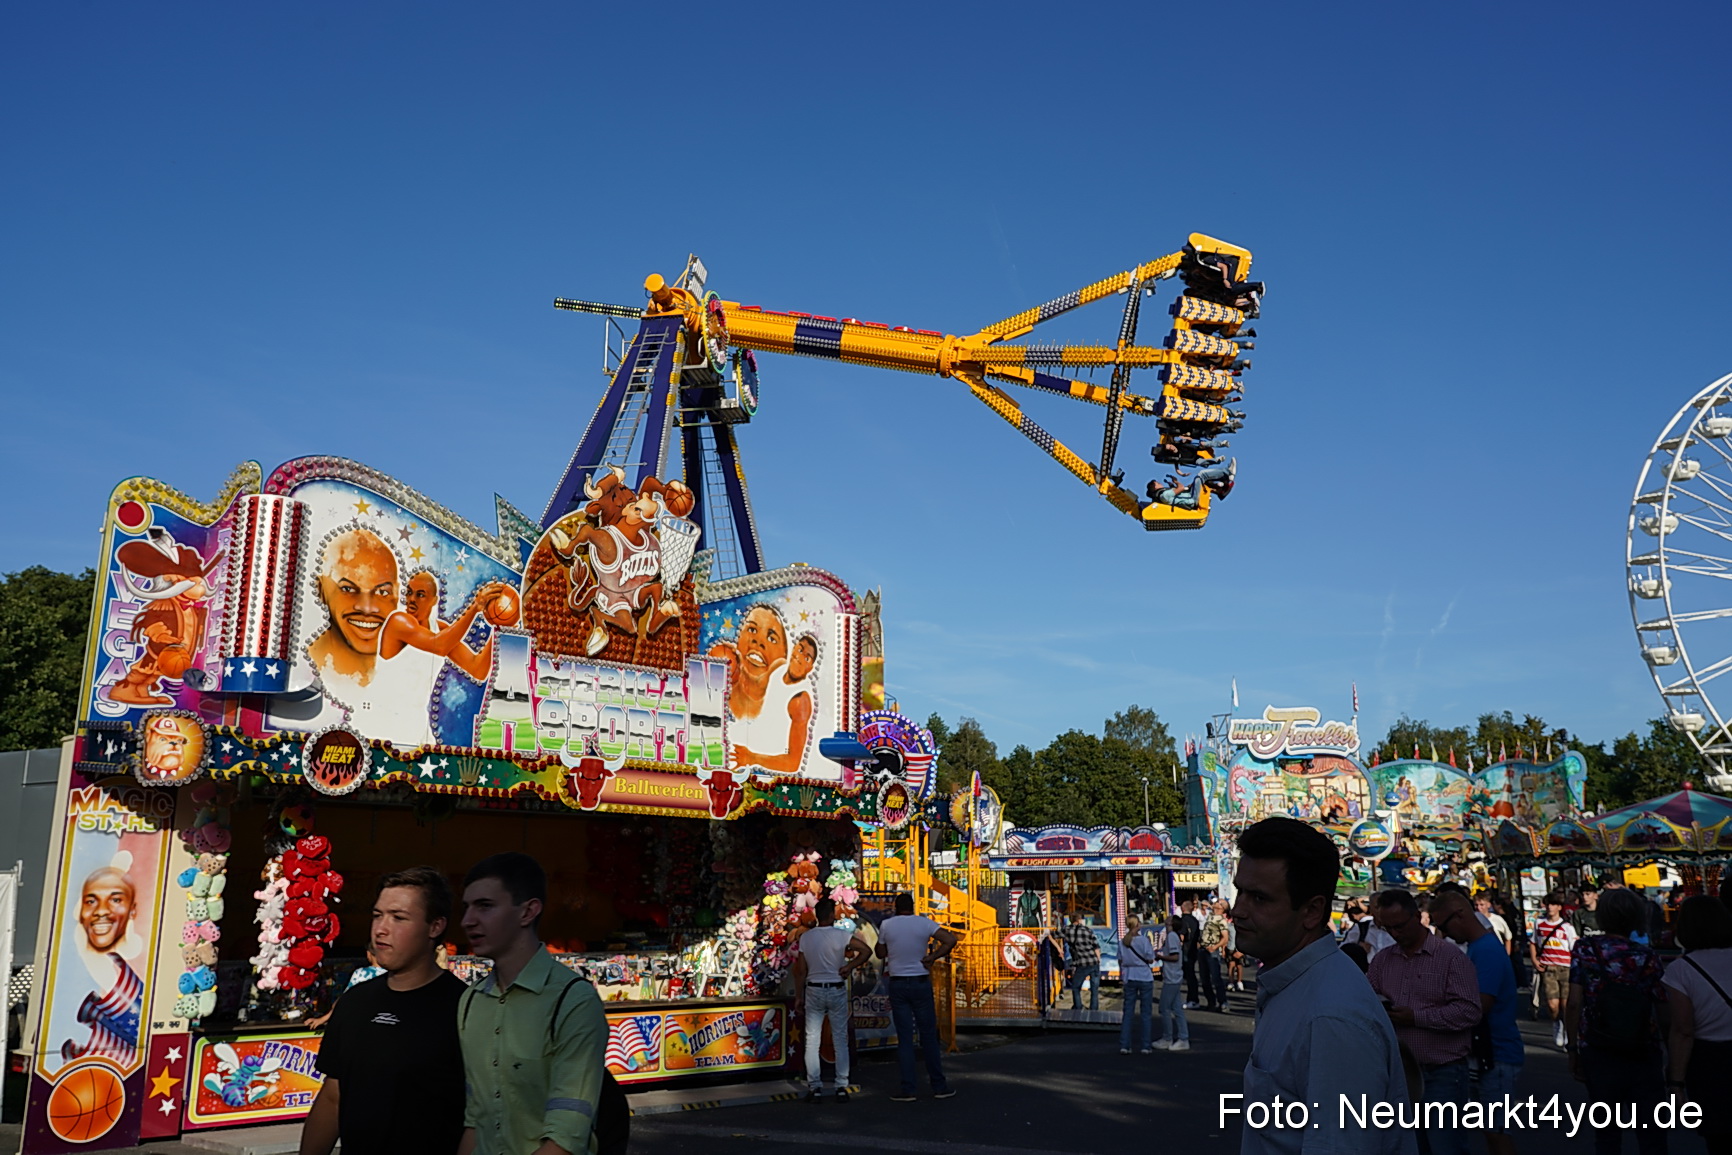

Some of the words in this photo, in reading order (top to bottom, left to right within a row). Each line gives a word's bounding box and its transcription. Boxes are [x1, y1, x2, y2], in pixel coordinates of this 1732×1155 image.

[619, 550, 659, 586] BULLS
[95, 571, 148, 716] VEGAS
[478, 632, 727, 768] AMERICAN
[164, 720, 173, 728] G
[537, 697, 687, 763] SPORT
[1232, 722, 1281, 747] HAPPY
[1251, 709, 1357, 754] Traveller
[321, 753, 355, 765] HEAT
[324, 745, 356, 756] MIAMI
[614, 778, 704, 799] Ballwerfen
[69, 785, 175, 818] MAGIC
[885, 800, 904, 809] HEAT
[1022, 858, 1048, 866] FLIGHT
[1048, 858, 1069, 866] AREA
[851, 997, 888, 1012] ORCE
[689, 1012, 745, 1056] HORNETS
[695, 1055, 735, 1067] TEAM
[284, 1093, 315, 1106] TE
